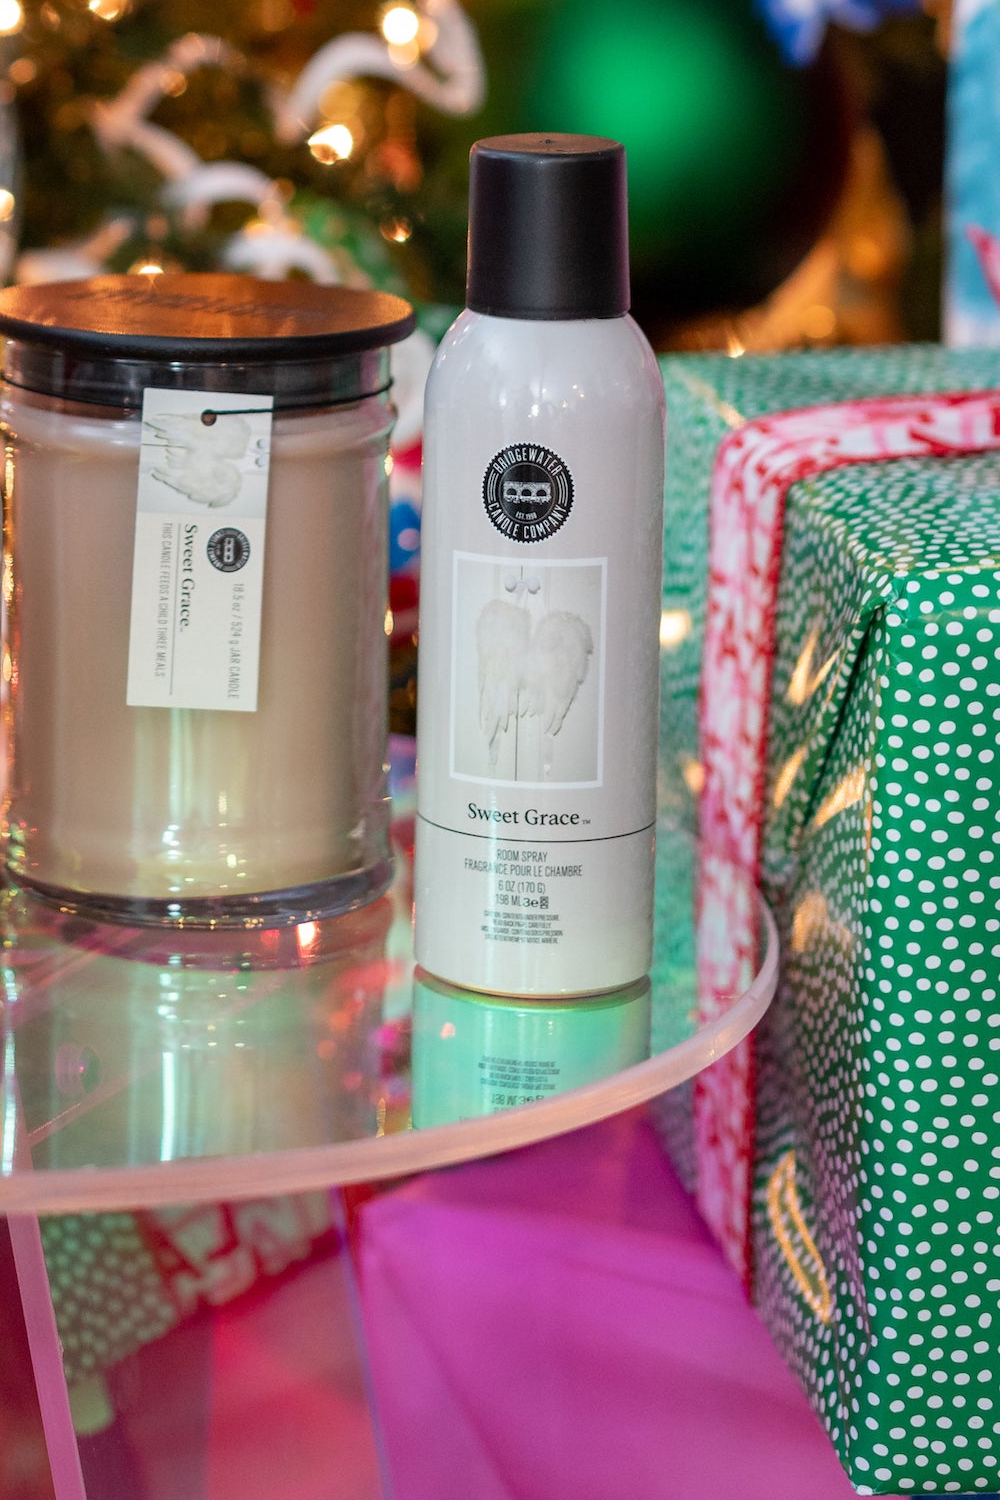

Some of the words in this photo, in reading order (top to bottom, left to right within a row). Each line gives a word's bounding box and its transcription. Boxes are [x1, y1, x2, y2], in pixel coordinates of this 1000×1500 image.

[492, 447, 563, 476] BRIDGEWATER
[161, 523, 173, 539] THIS
[488, 502, 520, 536] CANDLE
[523, 504, 567, 539] COMPANY
[160, 541, 172, 569] CANDLE
[182, 523, 199, 573] Sweet
[159, 571, 170, 597] FEEDS
[157, 603, 168, 625] CHILD
[156, 627, 168, 649] THREE
[155, 652, 166, 677] MEALS
[230, 647, 241, 664] JAR
[228, 666, 240, 699] CANDLE
[467, 802, 519, 824] Sweet
[496, 849, 520, 862] ROOM
[521, 850, 548, 863] SPRAY
[464, 858, 508, 875] FRAGRANCE
[510, 864, 532, 877] POUR
[533, 865, 543, 877] LE
[544, 864, 583, 877] CHAMBRE
[498, 880, 504, 891] 6
[505, 880, 515, 892] OZ
[517, 881, 535, 893] (170
[495, 894, 509, 906] 198
